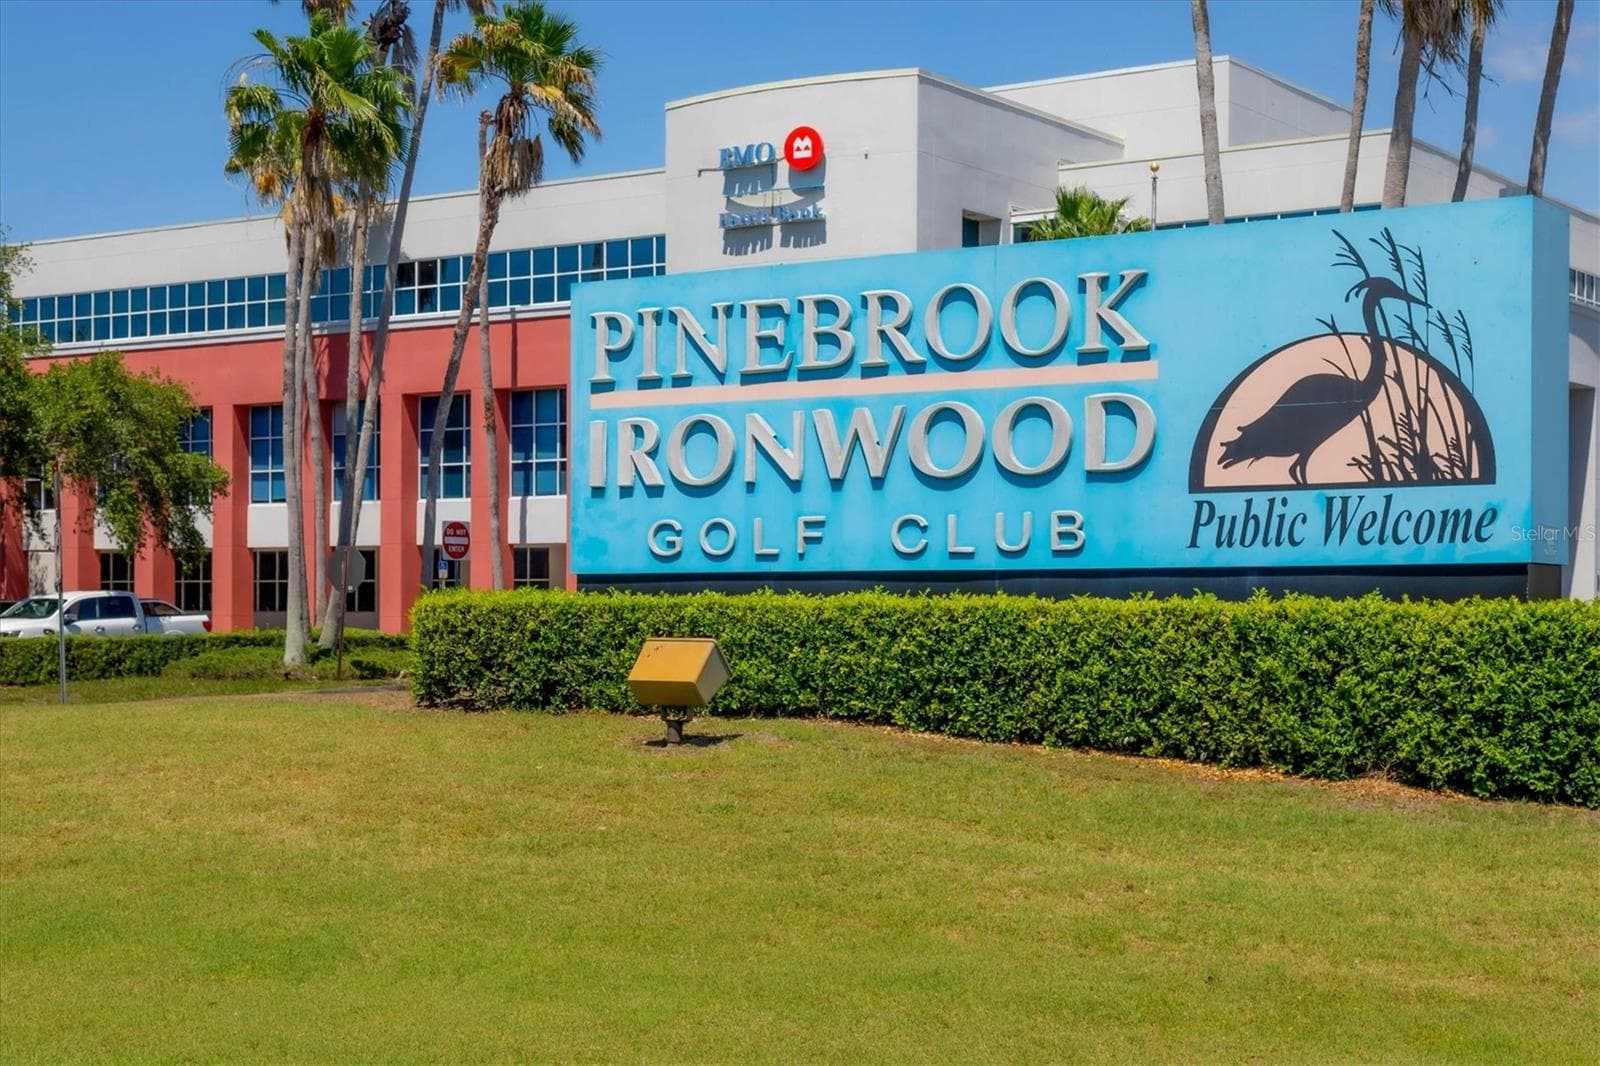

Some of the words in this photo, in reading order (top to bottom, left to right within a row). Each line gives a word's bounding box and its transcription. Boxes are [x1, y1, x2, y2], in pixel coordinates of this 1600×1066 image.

[588, 269, 1150, 384] PINEBROOK
[588, 392, 1157, 488] IRONWOOD
[647, 515, 827, 558] GOLF
[890, 510, 1086, 555] CLUB
[1186, 495, 1307, 549] Public
[1322, 493, 1499, 548] Welcome
